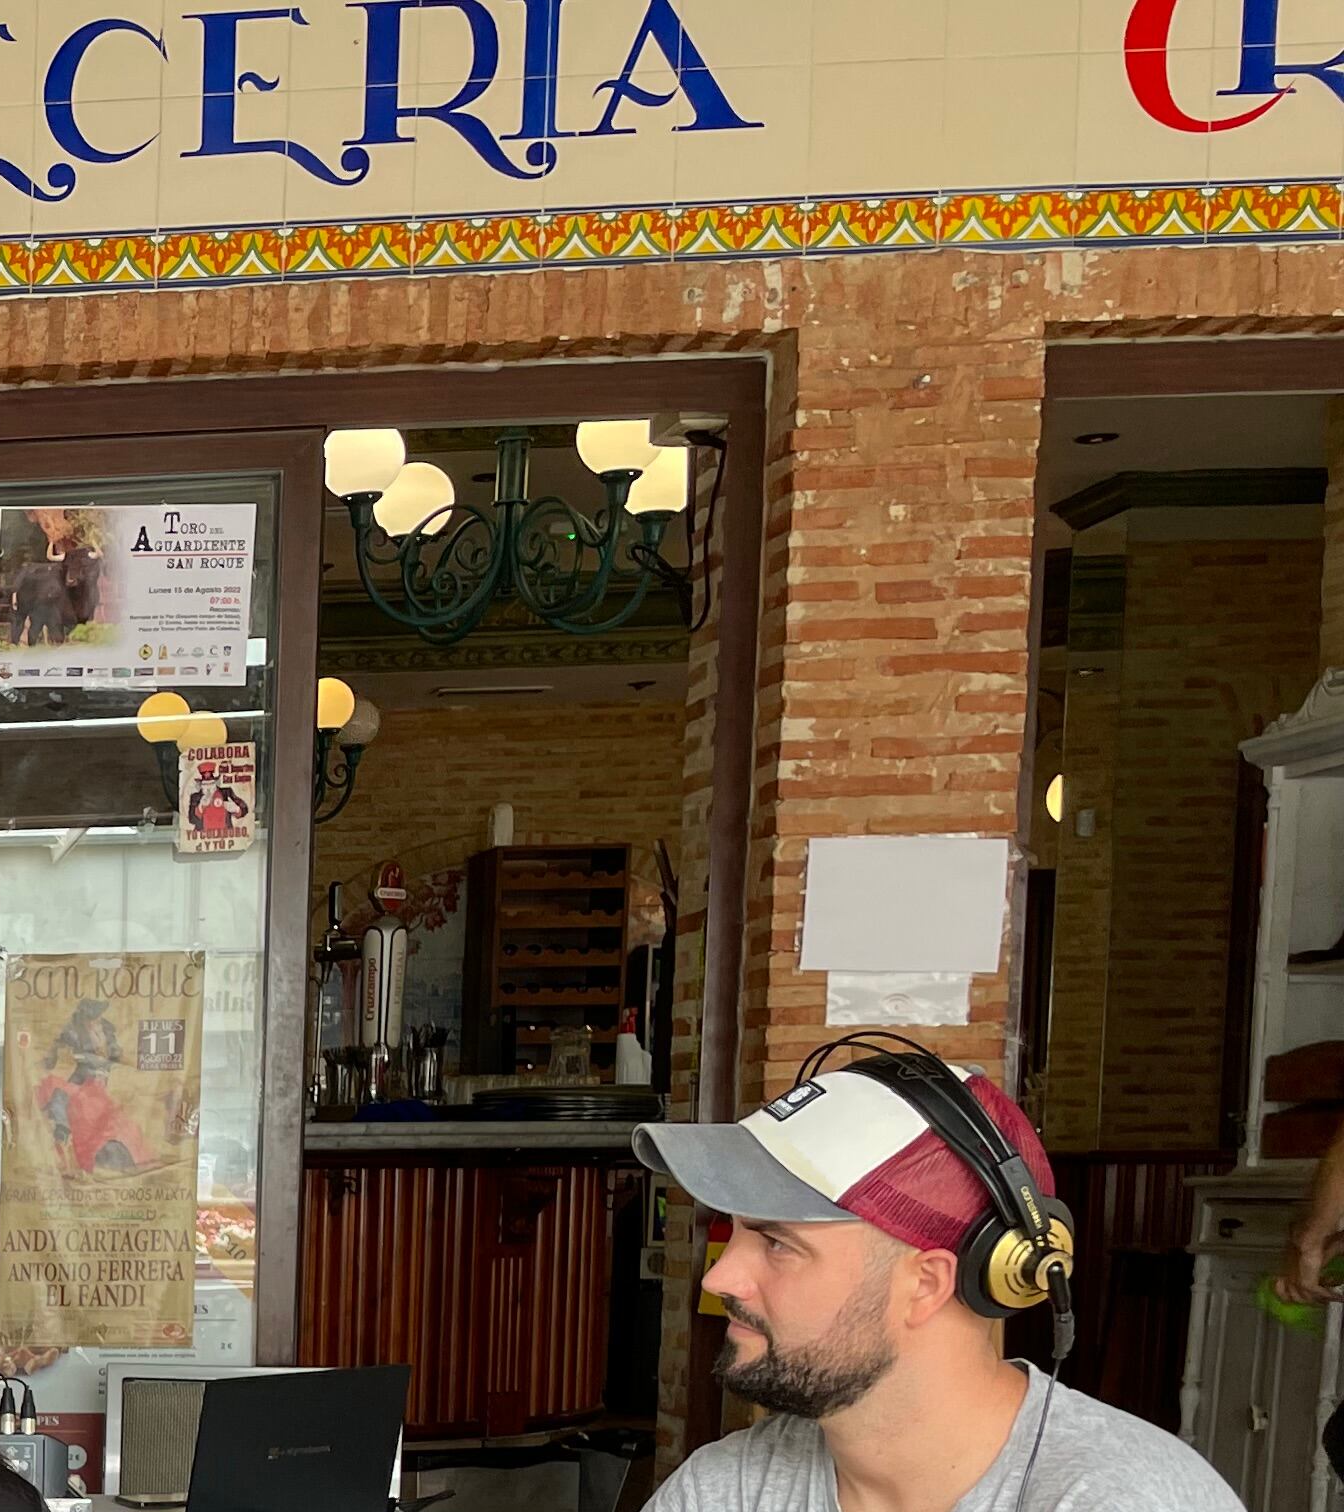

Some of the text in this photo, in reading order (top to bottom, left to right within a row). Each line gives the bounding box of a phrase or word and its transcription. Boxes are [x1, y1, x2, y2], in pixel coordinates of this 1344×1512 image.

[167, 557, 244, 569] SAN ROQUE
[188, 746, 250, 760] COLABORA
[142, 1032, 175, 1054] 11
[112, 1188, 151, 1201] TOROS
[154, 1188, 193, 1201] MIXTA
[2, 1228, 191, 1252] ANDY CARTAGENA
[8, 1260, 184, 1282] ANTONIO FERRERA
[46, 1285, 146, 1307] EL FANDI
